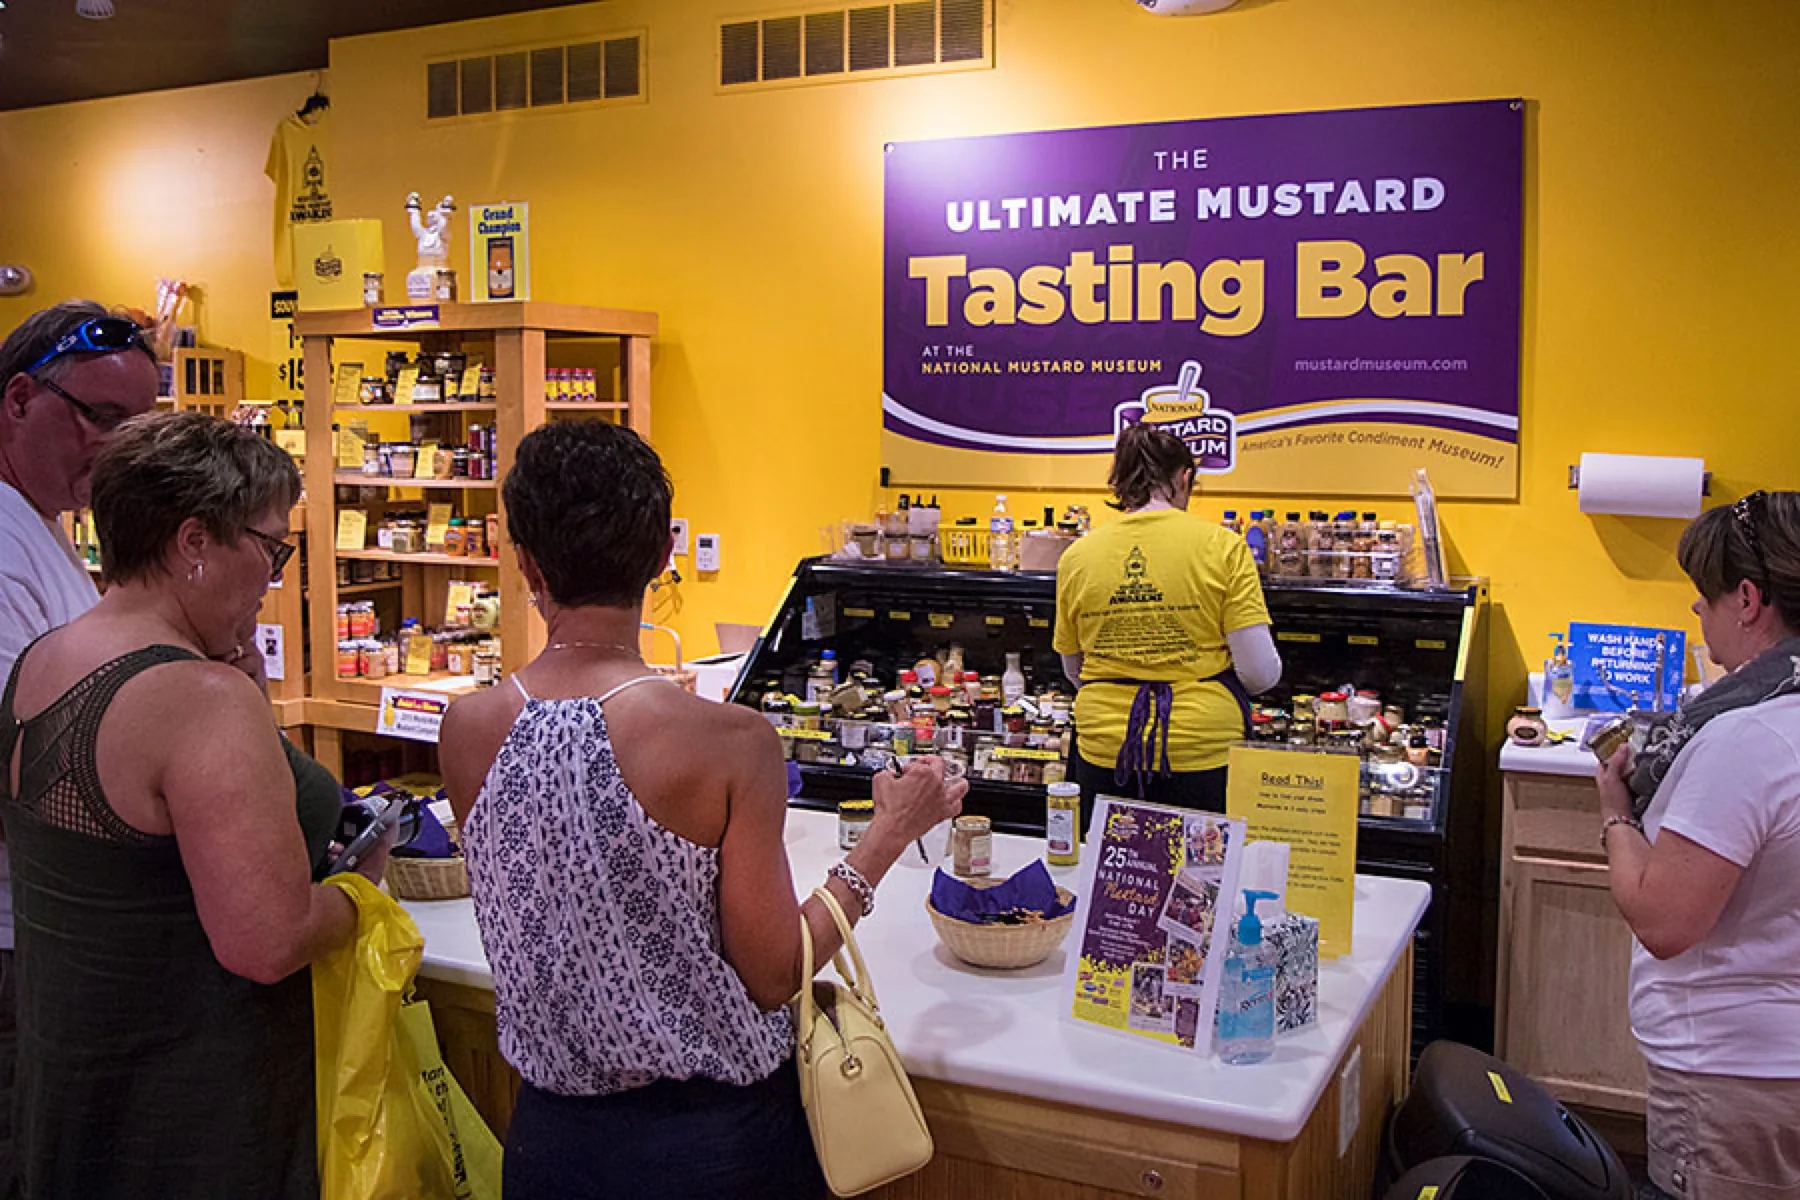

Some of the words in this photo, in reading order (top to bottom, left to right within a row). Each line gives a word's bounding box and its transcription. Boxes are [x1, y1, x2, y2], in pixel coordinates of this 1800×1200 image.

[1154, 149, 1209, 171] THE
[483, 206, 513, 220] Grand
[946, 189, 1177, 232] ULTIMATE
[1197, 178, 1446, 219] MUSTARD
[478, 221, 521, 237] Champion
[908, 244, 1266, 336] Tasting
[1295, 240, 1485, 320] Bar
[921, 345, 939, 357] AT
[946, 344, 975, 356] THE
[921, 361, 1001, 374] NATIONAL
[1008, 360, 1084, 373] MUSTARD
[1091, 359, 1162, 372] MUSEUM
[1295, 357, 1468, 374] mustardmuseum.com
[1242, 434, 1293, 451] America's
[1295, 432, 1344, 446] Favorite
[1347, 431, 1425, 449] Condiment
[1428, 438, 1505, 469] Museum!
[1587, 633, 1622, 643] WASH
[1624, 635, 1657, 648] HAND
[1601, 647, 1649, 659] BEFORE
[1616, 672, 1651, 684] WORK
[1261, 771, 1291, 785] Read
[1295, 774, 1325, 788] This!
[1104, 846, 1127, 868] 25
[1098, 869, 1159, 891] NATIONAL
[1127, 903, 1155, 917] DAY
